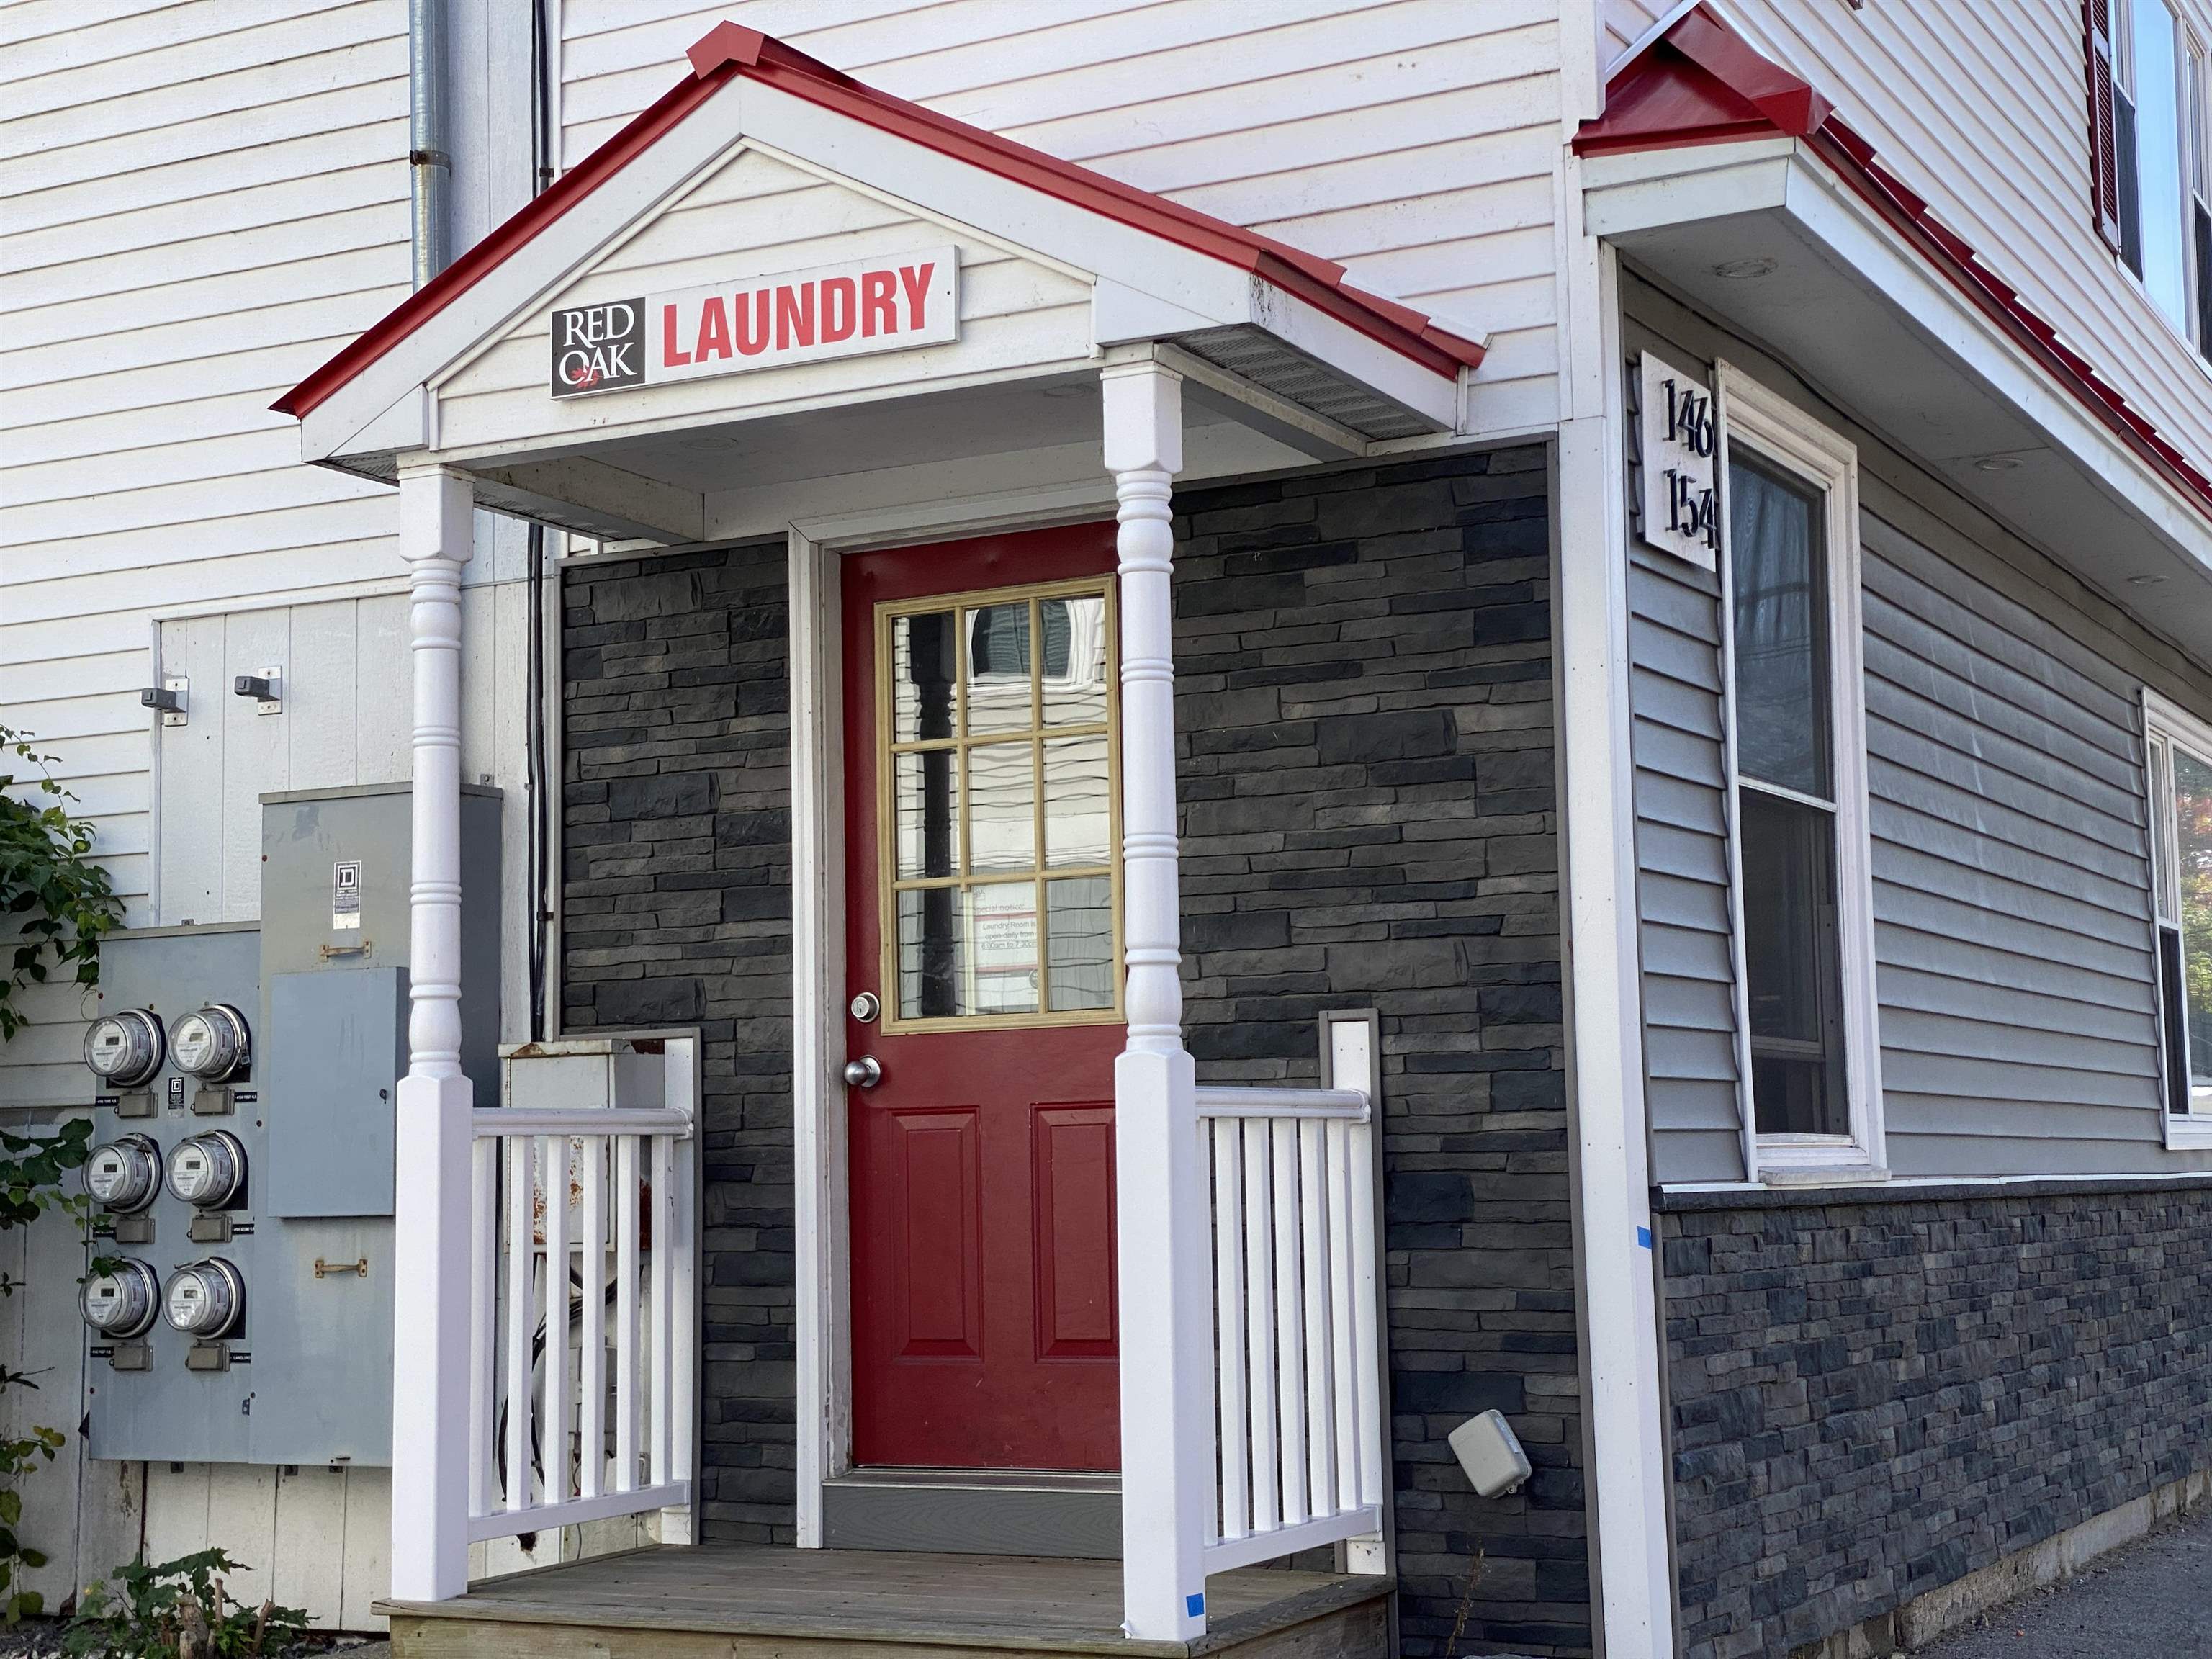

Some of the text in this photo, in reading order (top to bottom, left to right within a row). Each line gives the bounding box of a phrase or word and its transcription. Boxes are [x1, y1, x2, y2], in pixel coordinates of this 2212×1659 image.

[562, 304, 634, 349] RED
[663, 263, 935, 368] LAUNDRY
[559, 342, 637, 385] OAK
[1662, 379, 1714, 457] 146
[1664, 469, 1717, 549] 154
[982, 922, 1009, 930] Laundry
